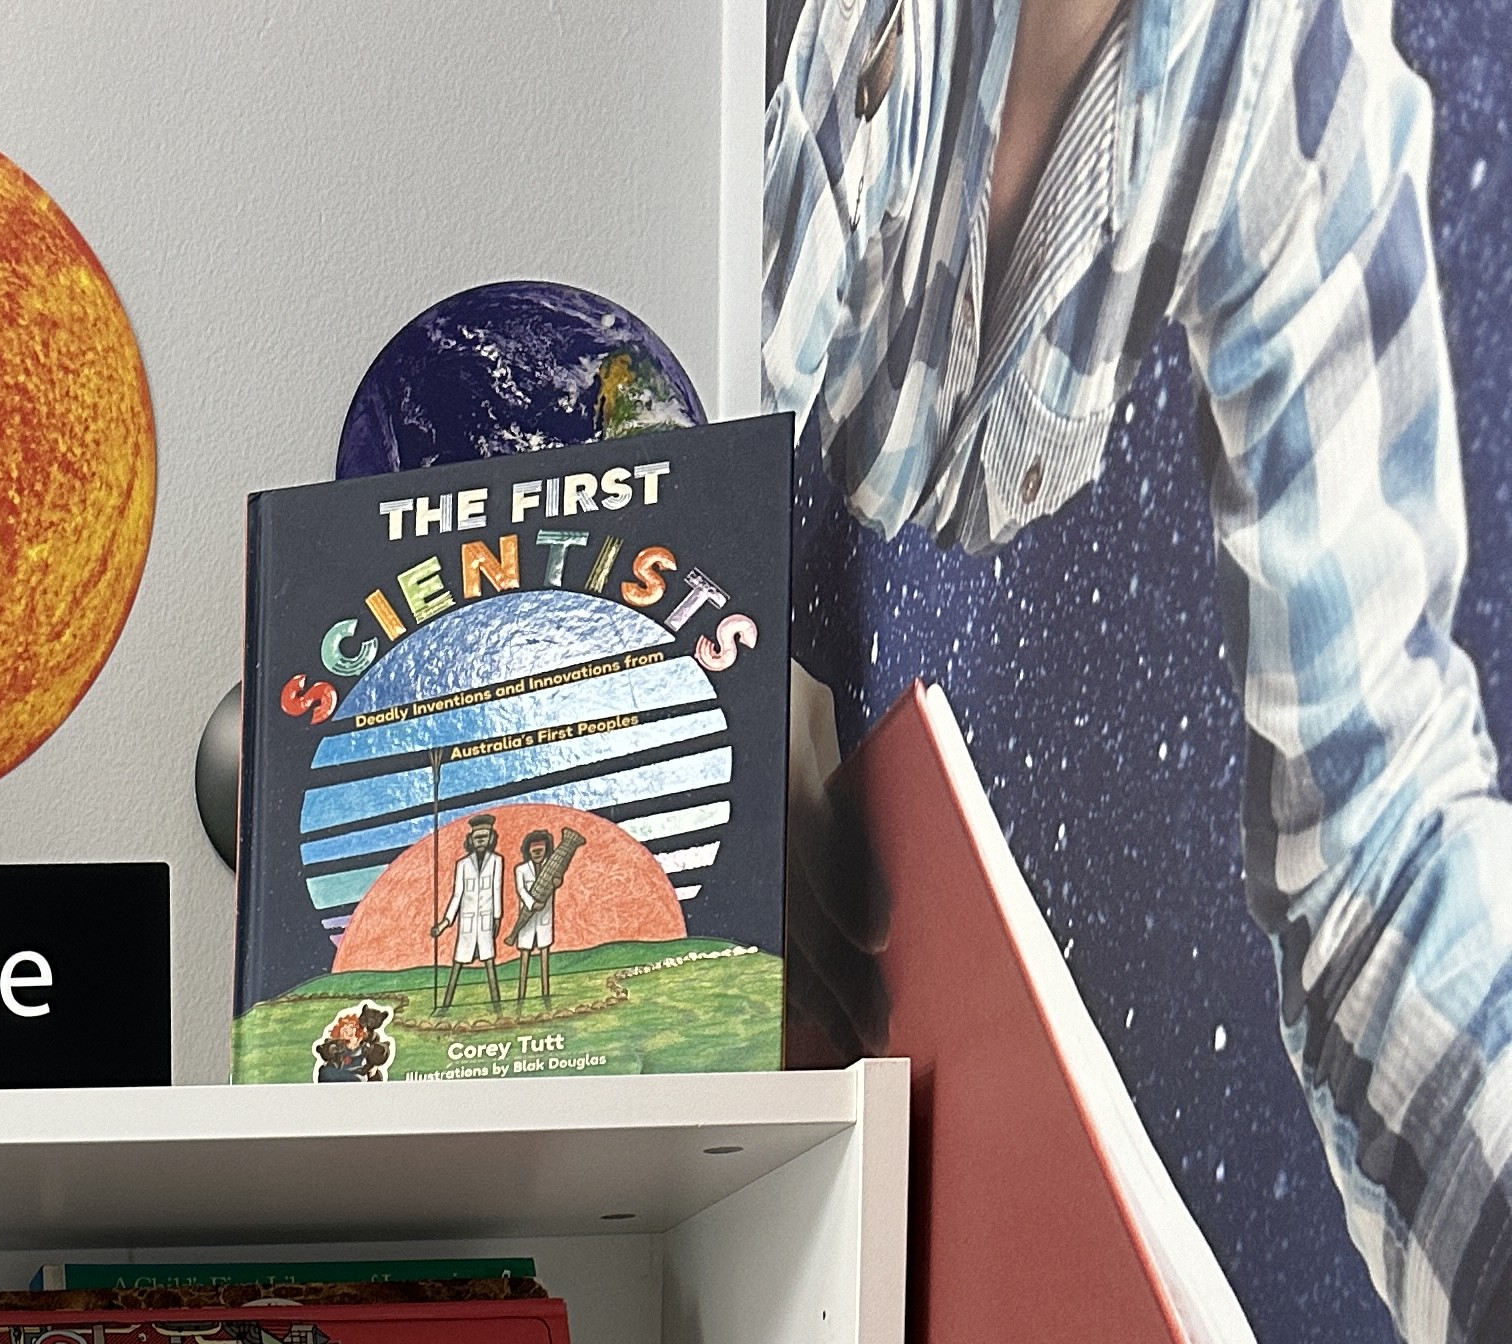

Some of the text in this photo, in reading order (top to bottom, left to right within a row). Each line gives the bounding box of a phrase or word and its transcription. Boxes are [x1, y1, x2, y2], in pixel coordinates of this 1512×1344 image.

[379, 462, 670, 540] THE FIRST
[280, 529, 757, 725] SCIENTISTS
[354, 649, 665, 729] Deadly Inventions and Innovations from
[537, 726, 574, 744] First
[577, 714, 639, 739] Peoples
[405, 1053, 607, 1082] Illustrations by Blak Douglas
[447, 1033, 565, 1061] Corey Tutt
